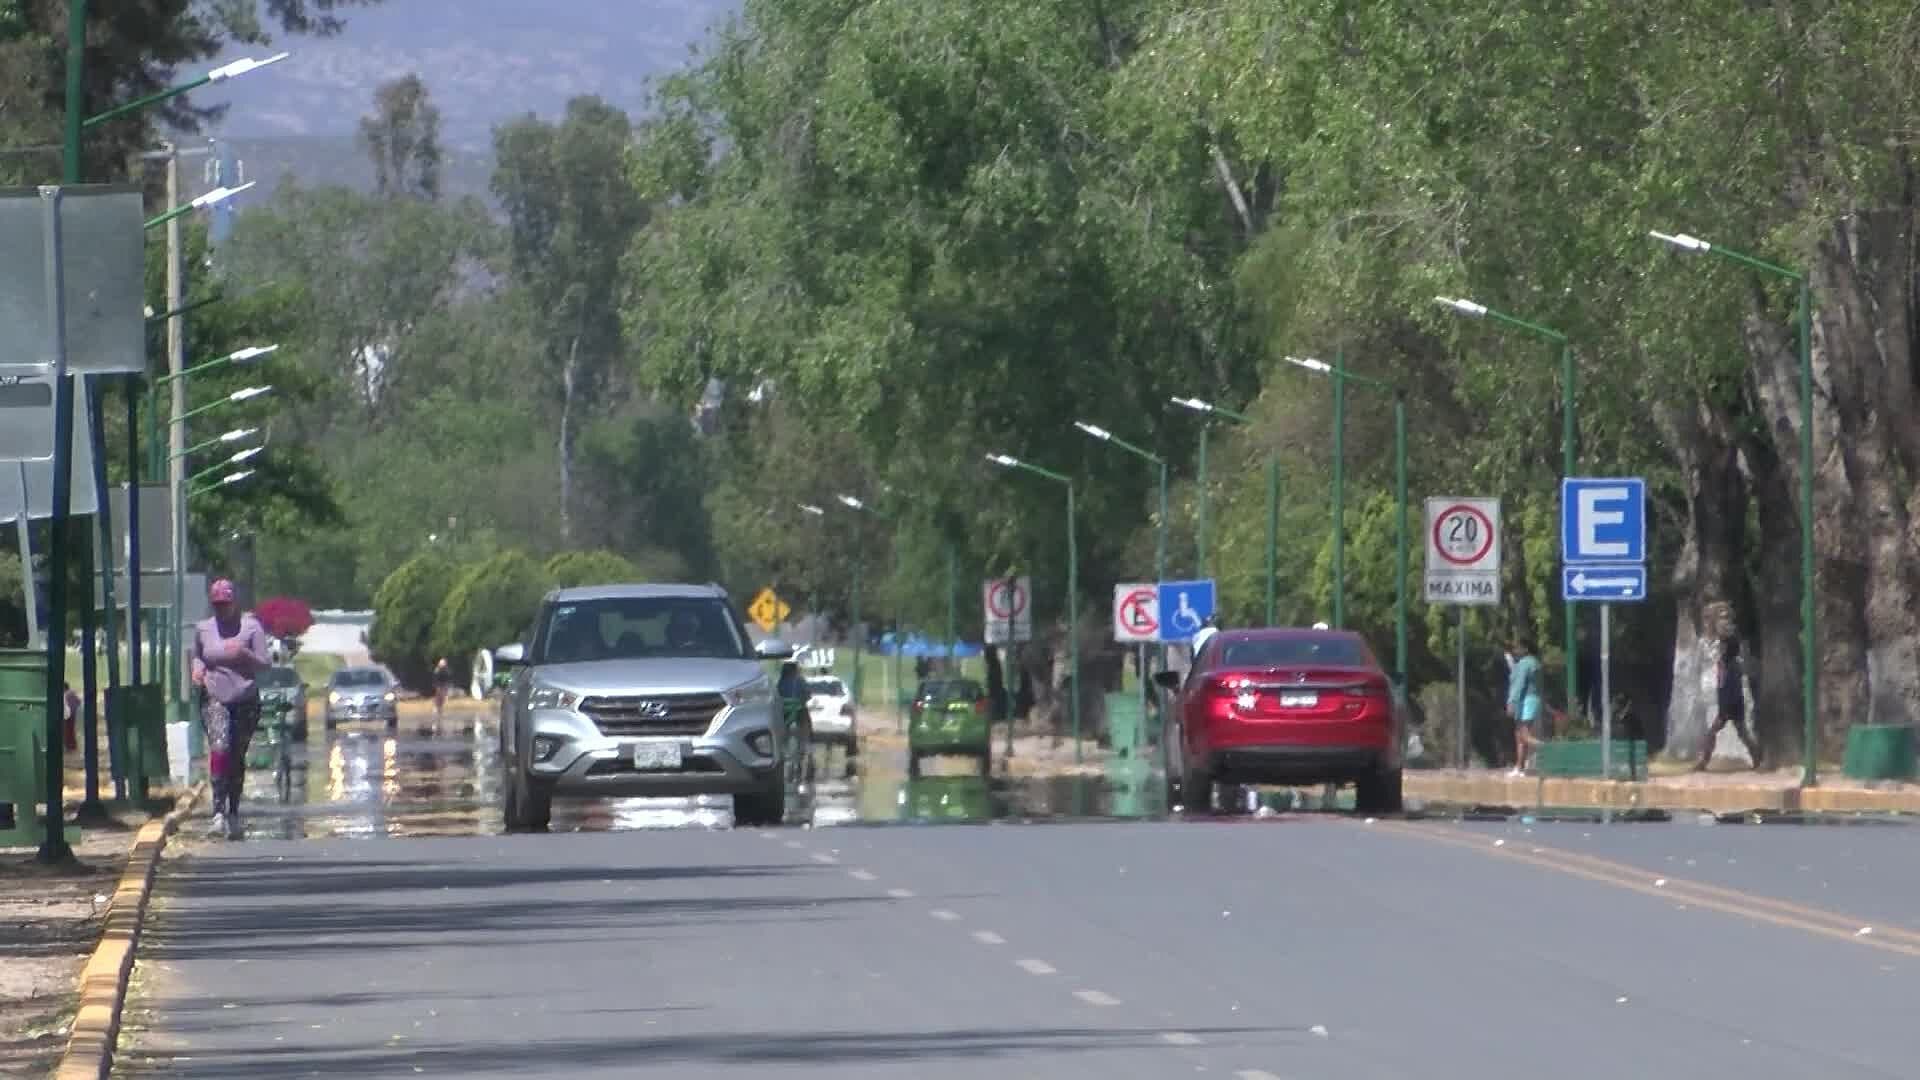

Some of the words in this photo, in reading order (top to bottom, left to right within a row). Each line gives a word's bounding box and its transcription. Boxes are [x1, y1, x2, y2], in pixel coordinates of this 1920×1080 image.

[1449, 515, 1478, 543] 20
[1578, 488, 1629, 556] E
[1429, 581, 1494, 597] MAXIMA
